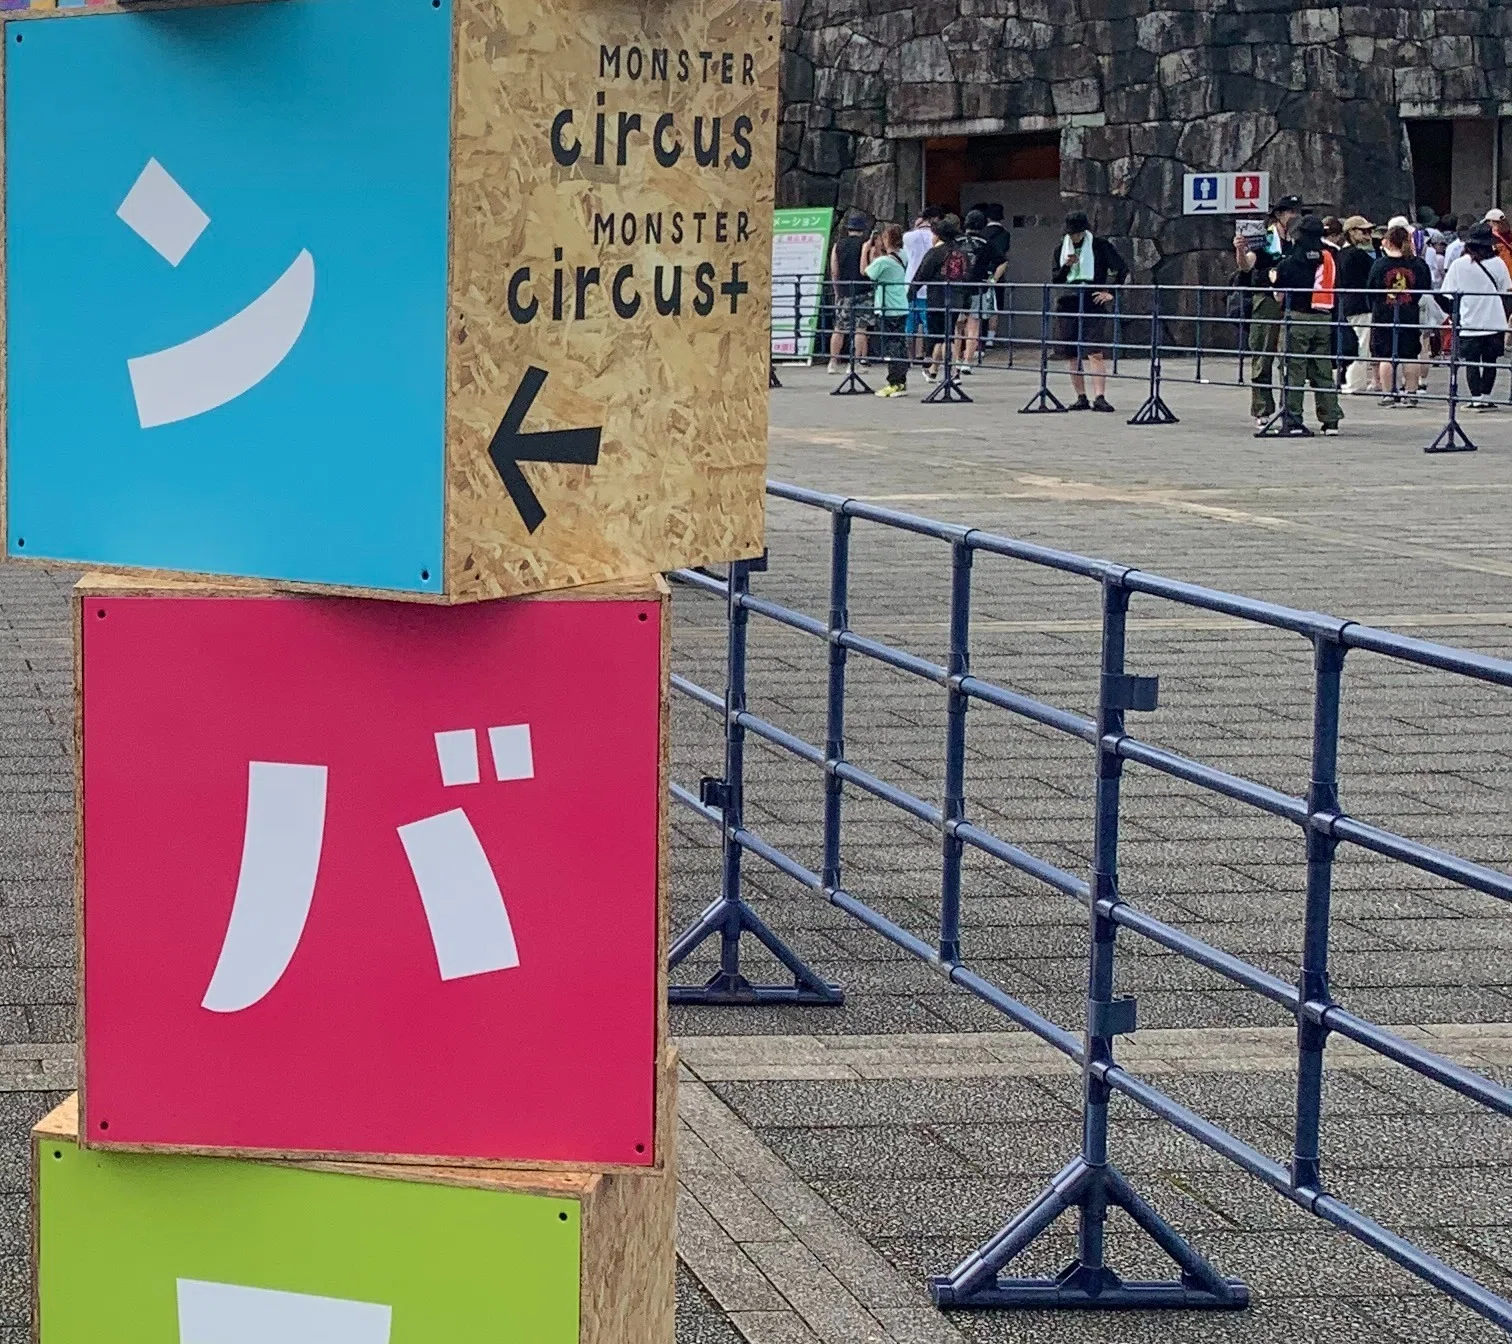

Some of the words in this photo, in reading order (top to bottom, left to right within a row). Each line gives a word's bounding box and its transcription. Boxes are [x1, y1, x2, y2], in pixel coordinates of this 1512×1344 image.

[599, 44, 756, 85] MONSTER
[550, 91, 754, 170] circus
[593, 211, 751, 246] MONSTER
[506, 247, 749, 325] circus+
